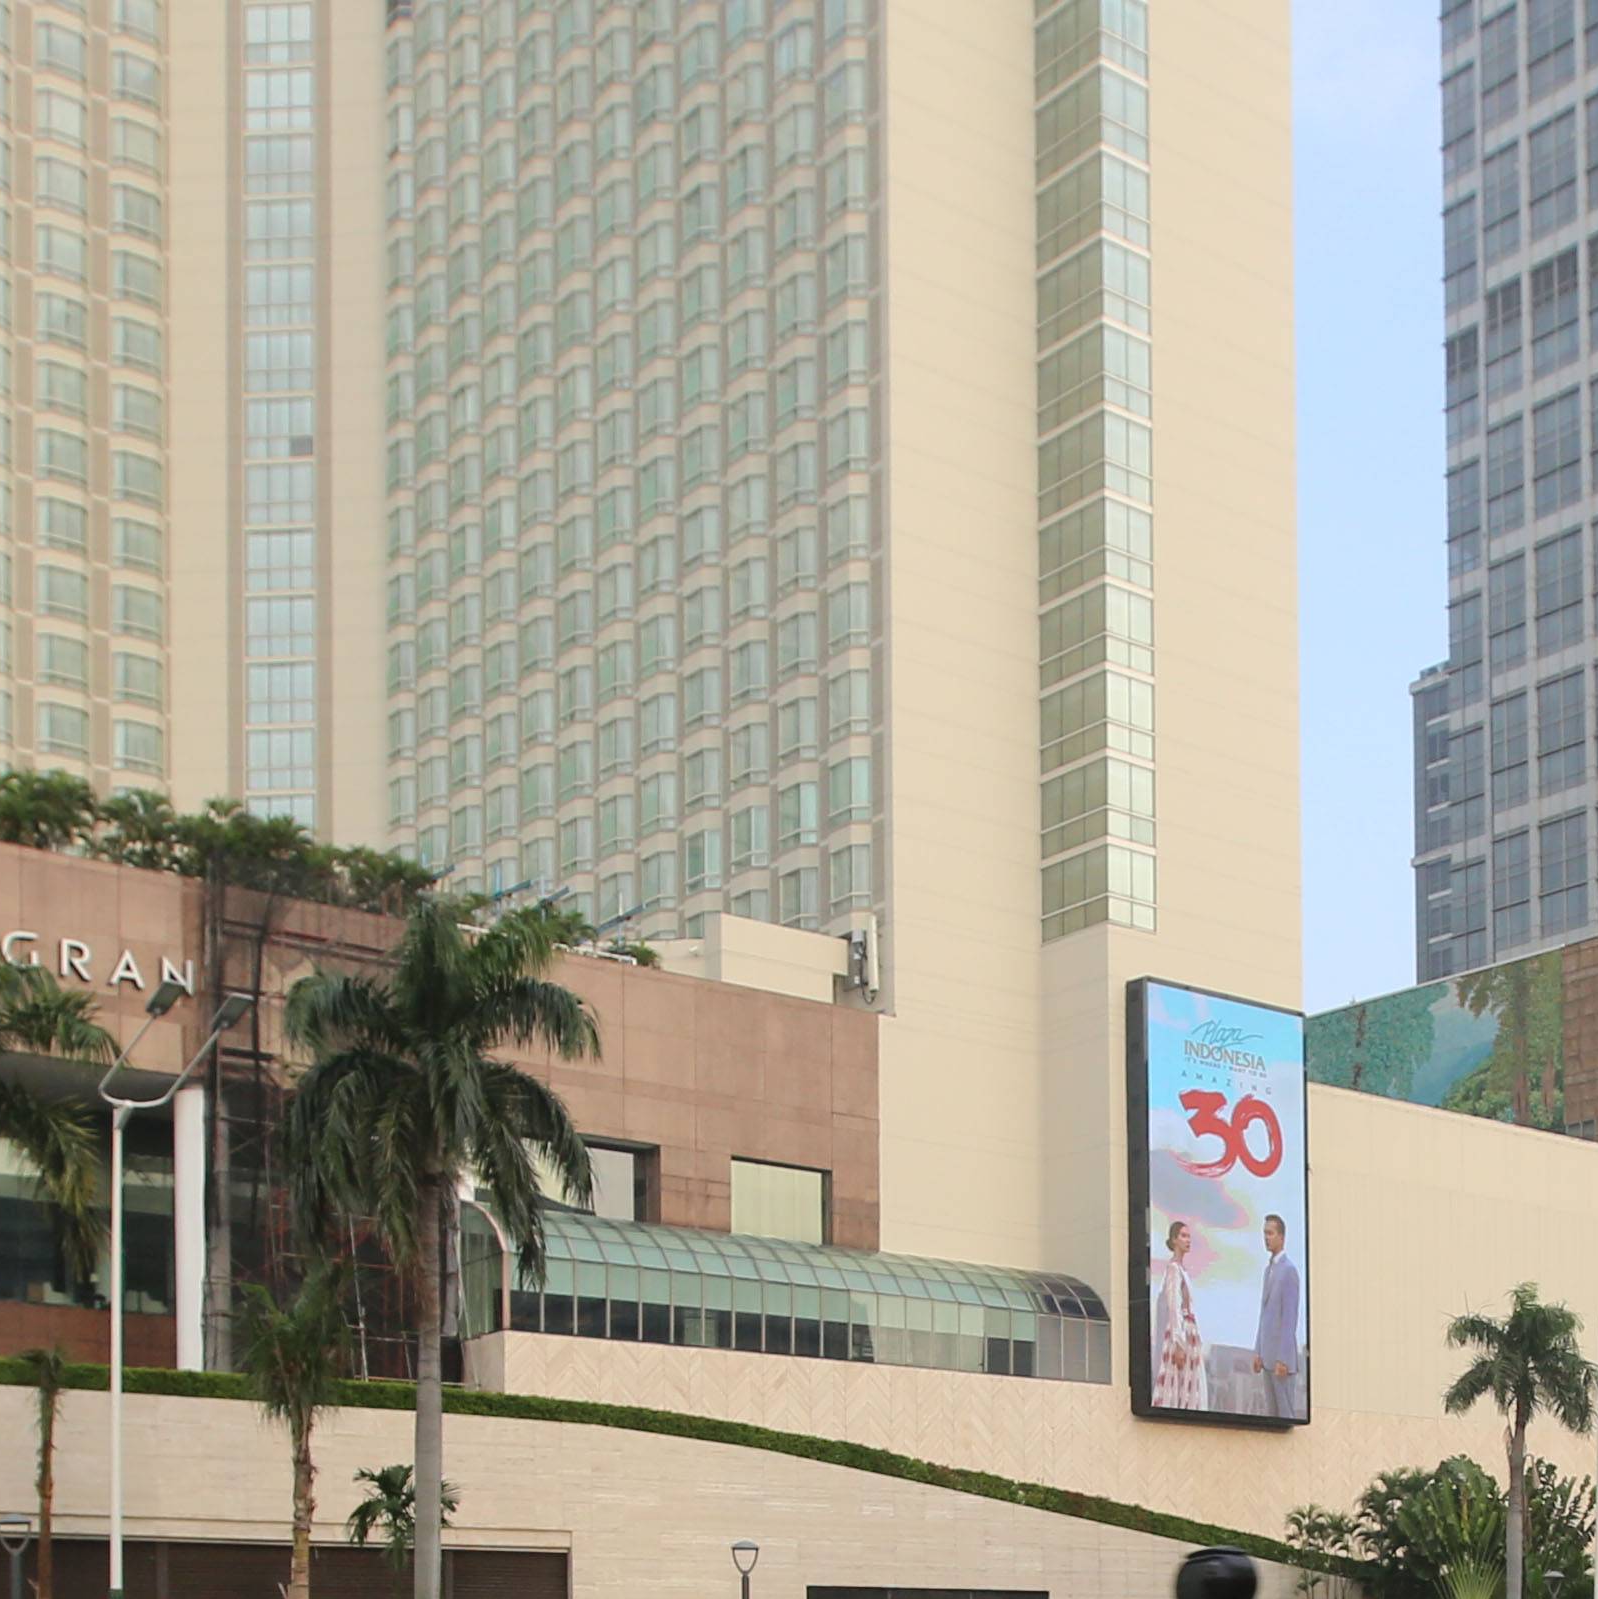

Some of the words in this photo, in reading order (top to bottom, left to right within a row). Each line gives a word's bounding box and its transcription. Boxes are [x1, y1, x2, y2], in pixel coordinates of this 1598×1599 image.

[1, 930, 195, 998] GRAN
[1191, 1019, 1263, 1048] Plaza
[1184, 1040, 1266, 1071] INDONESIA
[1181, 1070, 1272, 1095] AMAZING
[1169, 1089, 1283, 1178] 30
